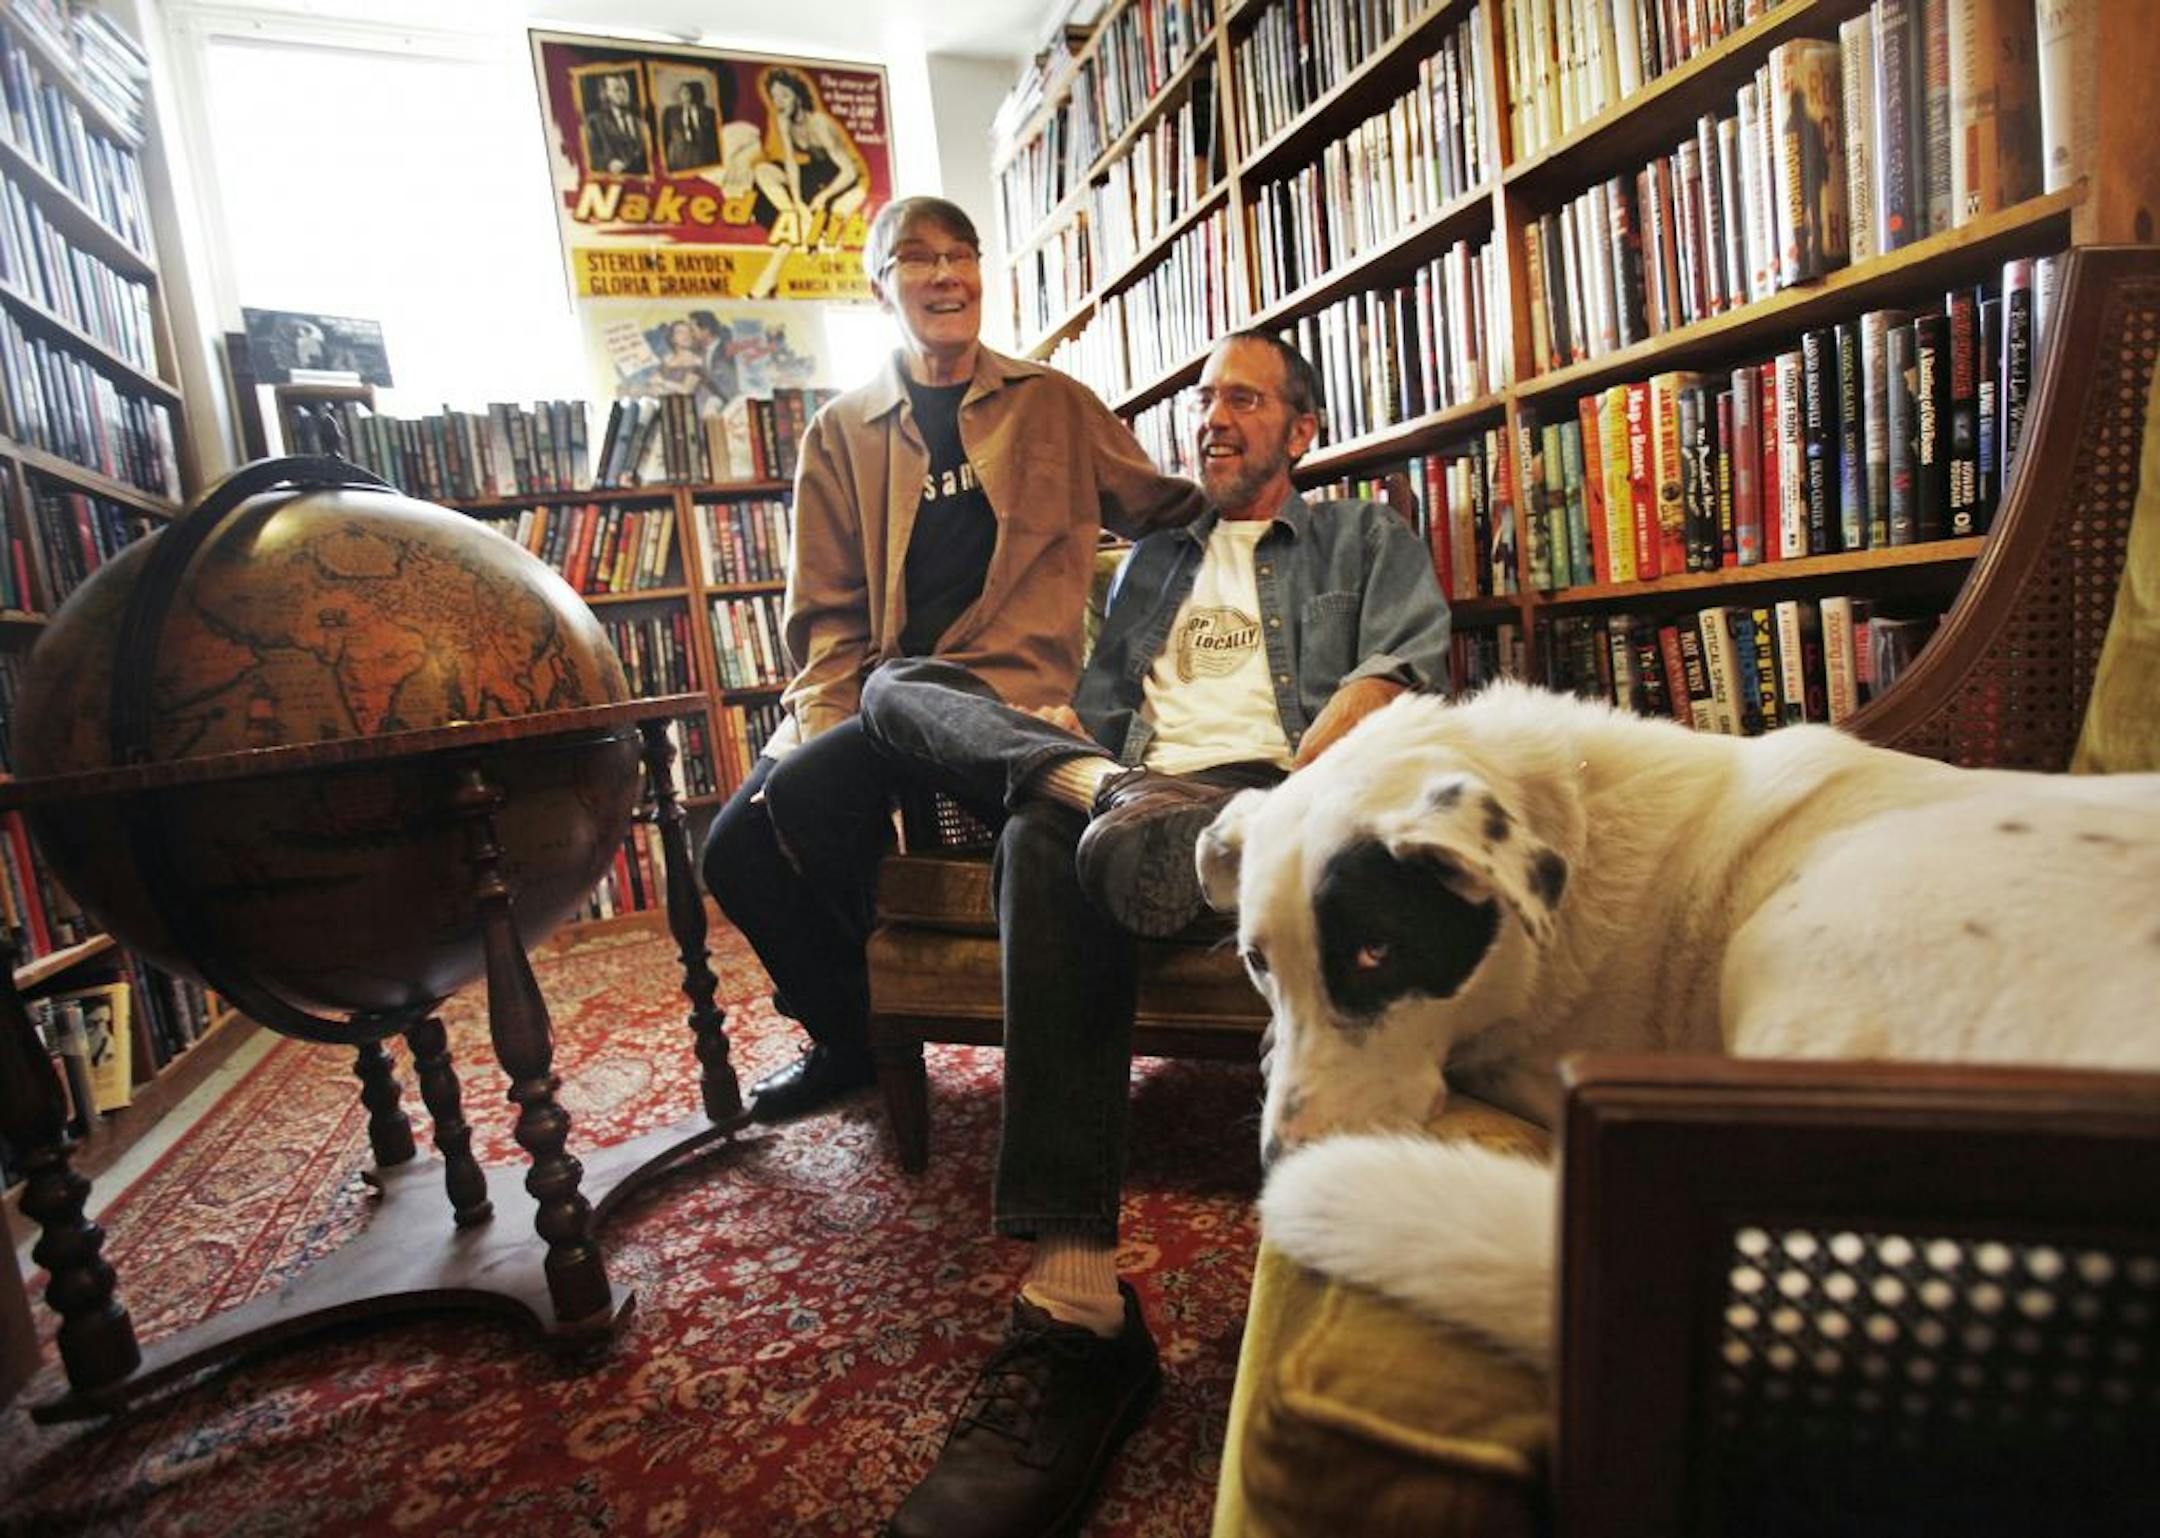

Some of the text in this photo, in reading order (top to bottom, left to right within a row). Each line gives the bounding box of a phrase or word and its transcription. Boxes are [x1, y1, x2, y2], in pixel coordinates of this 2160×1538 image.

[574, 182, 758, 226] Naked
[767, 207, 865, 251] Alib
[587, 253, 735, 274] STERLING HAYDEN
[590, 275, 733, 297] GLORIA GRAHAME
[1628, 388, 1644, 423] Map
[1785, 369, 1797, 444] HOME FRONT
[1631, 434, 1646, 480] Bones
[1195, 627, 1257, 650] LOCALLY
[1704, 615, 1721, 667] CRITICAL
[1713, 669, 1726, 704] SPACE
[1680, 631, 1705, 691] PLOT TWIST
